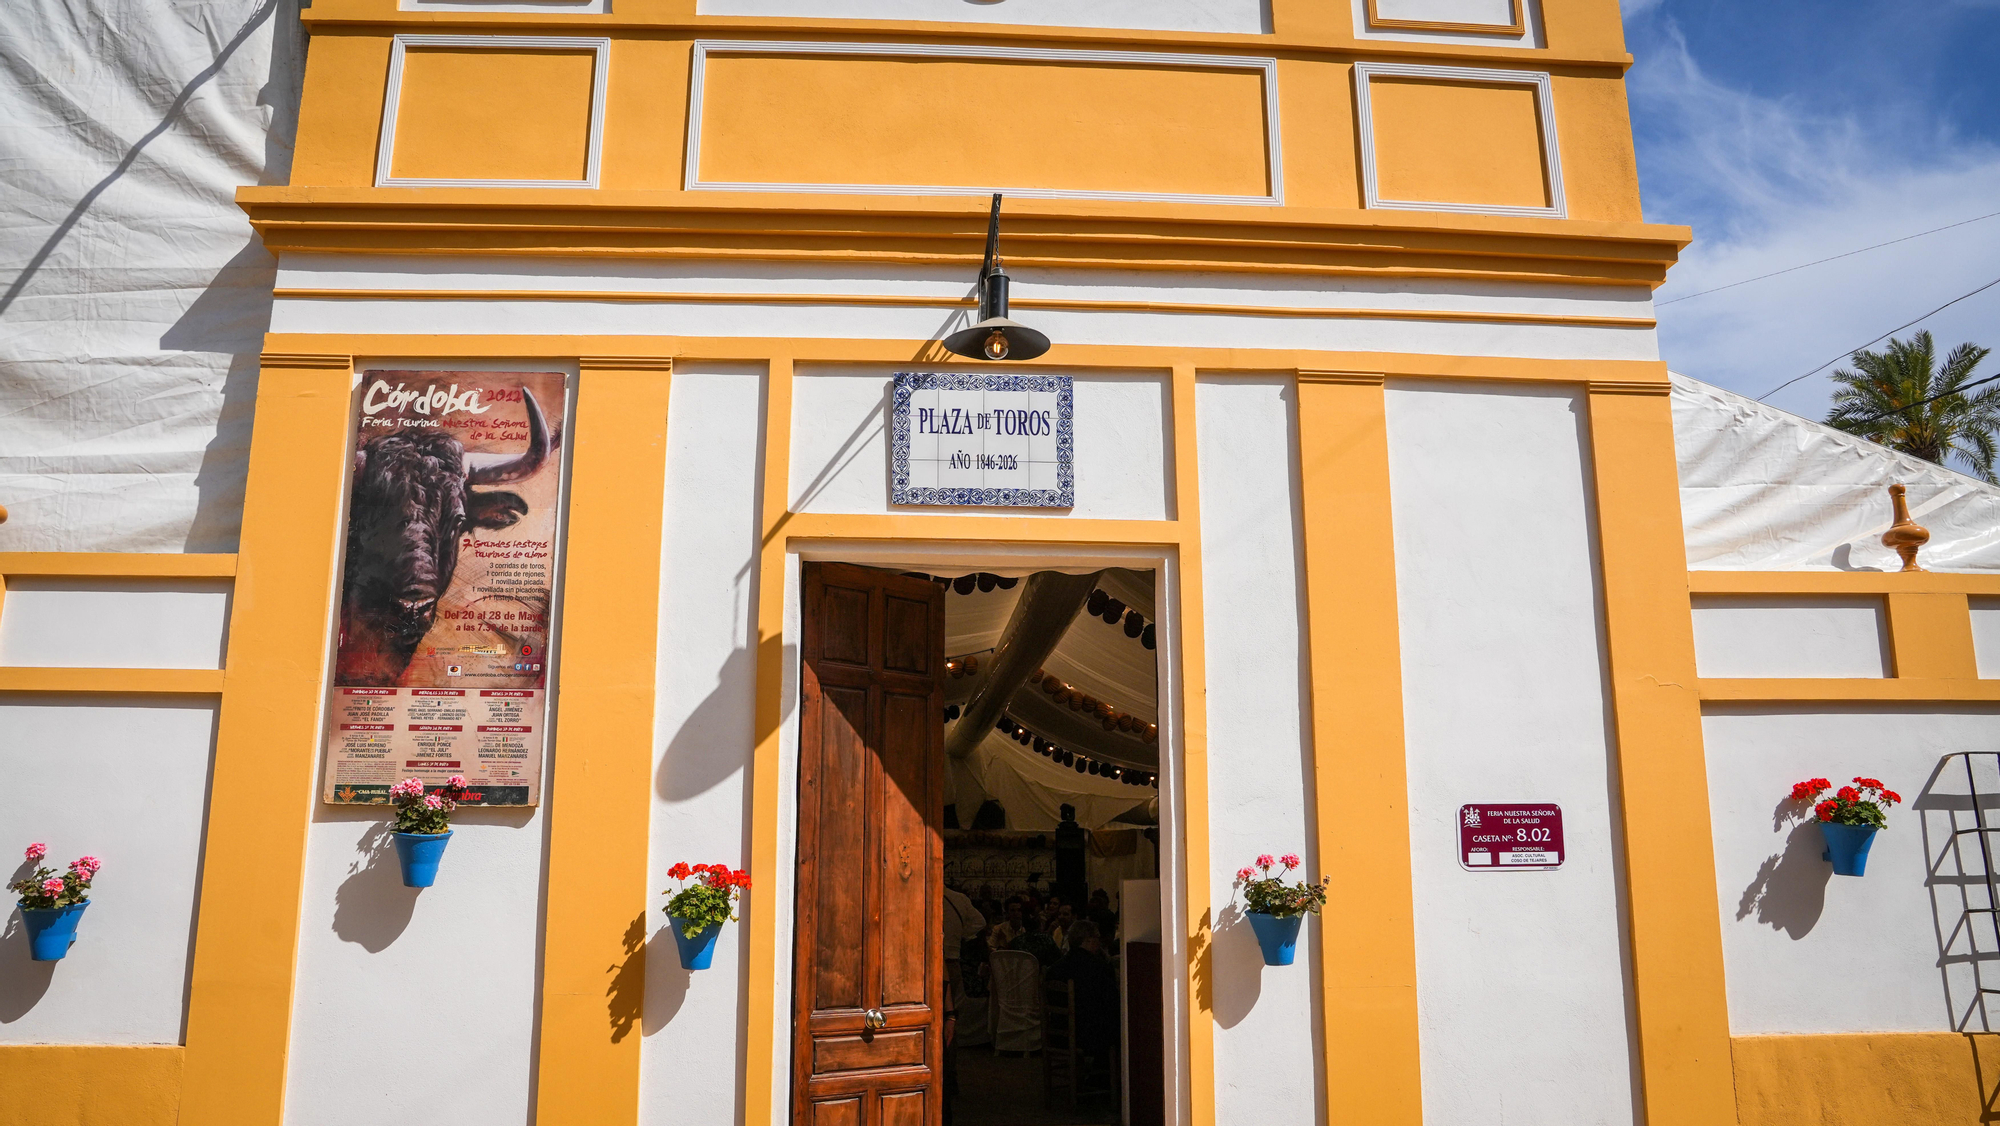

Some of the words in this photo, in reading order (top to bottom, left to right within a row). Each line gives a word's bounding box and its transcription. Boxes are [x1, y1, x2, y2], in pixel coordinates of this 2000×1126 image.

[363, 380, 492, 415] Córdoba
[486, 389, 521, 403] 2012
[362, 416, 394, 427] Feria
[397, 417, 440, 428] Taurina
[443, 419, 488, 428] Nuestra
[491, 418, 529, 429] Señora
[919, 408, 973, 434] PLAZA
[977, 413, 991, 430] DE
[994, 409, 1050, 436] TOROS
[470, 431, 482, 440] de
[485, 432, 496, 440] la
[500, 431, 528, 441] Salud
[949, 450, 971, 470] AÑO
[976, 454, 1018, 470] 1846-2026
[463, 538, 472, 552] 7
[474, 540, 511, 548] Grandes
[475, 550, 511, 558] taurinos
[444, 611, 459, 620] Del
[462, 611, 474, 619] 20
[477, 611, 485, 620] al
[489, 611, 501, 620] 28
[504, 612, 515, 620] de
[518, 612, 543, 622] Mayo
[1517, 828, 1551, 842] 8.02
